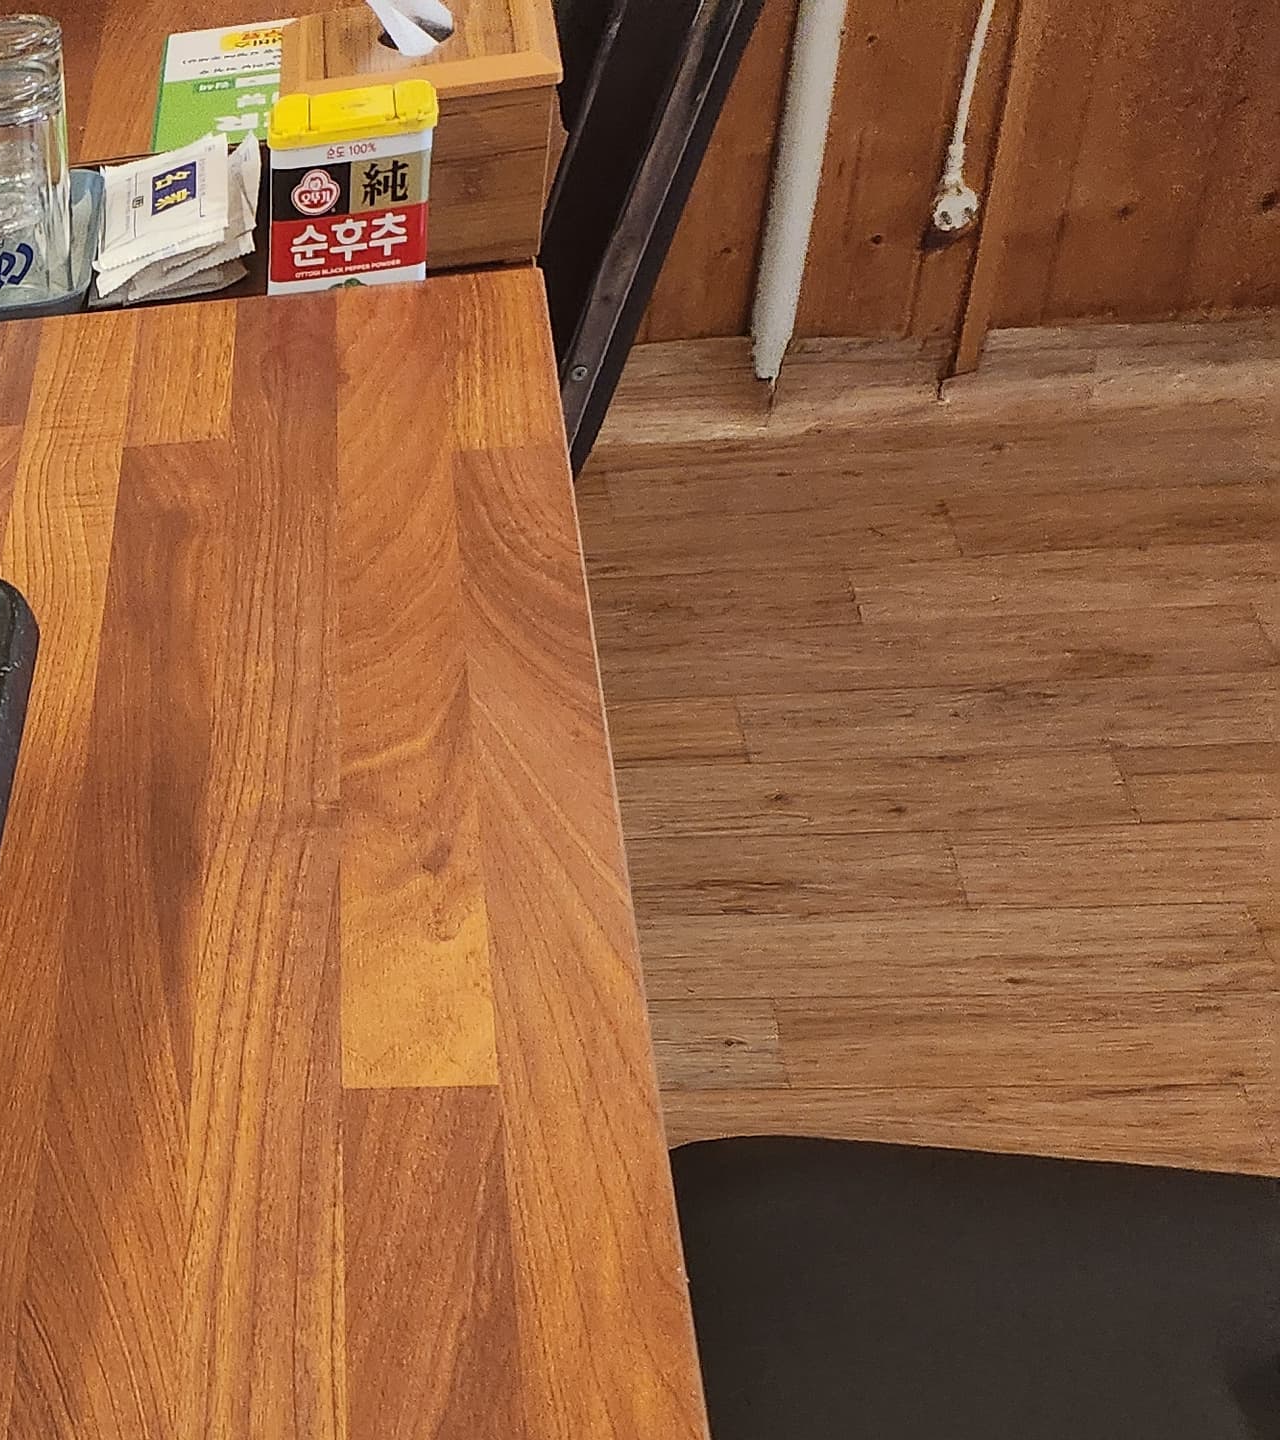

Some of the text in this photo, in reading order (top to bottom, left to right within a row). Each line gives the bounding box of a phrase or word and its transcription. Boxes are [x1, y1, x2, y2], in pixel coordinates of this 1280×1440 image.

[349, 142, 377, 156] 100%
[361, 160, 409, 207] 純
[290, 211, 408, 268] 순후추
[344, 263, 371, 273] PEPPER
[371, 258, 402, 269] POWDER
